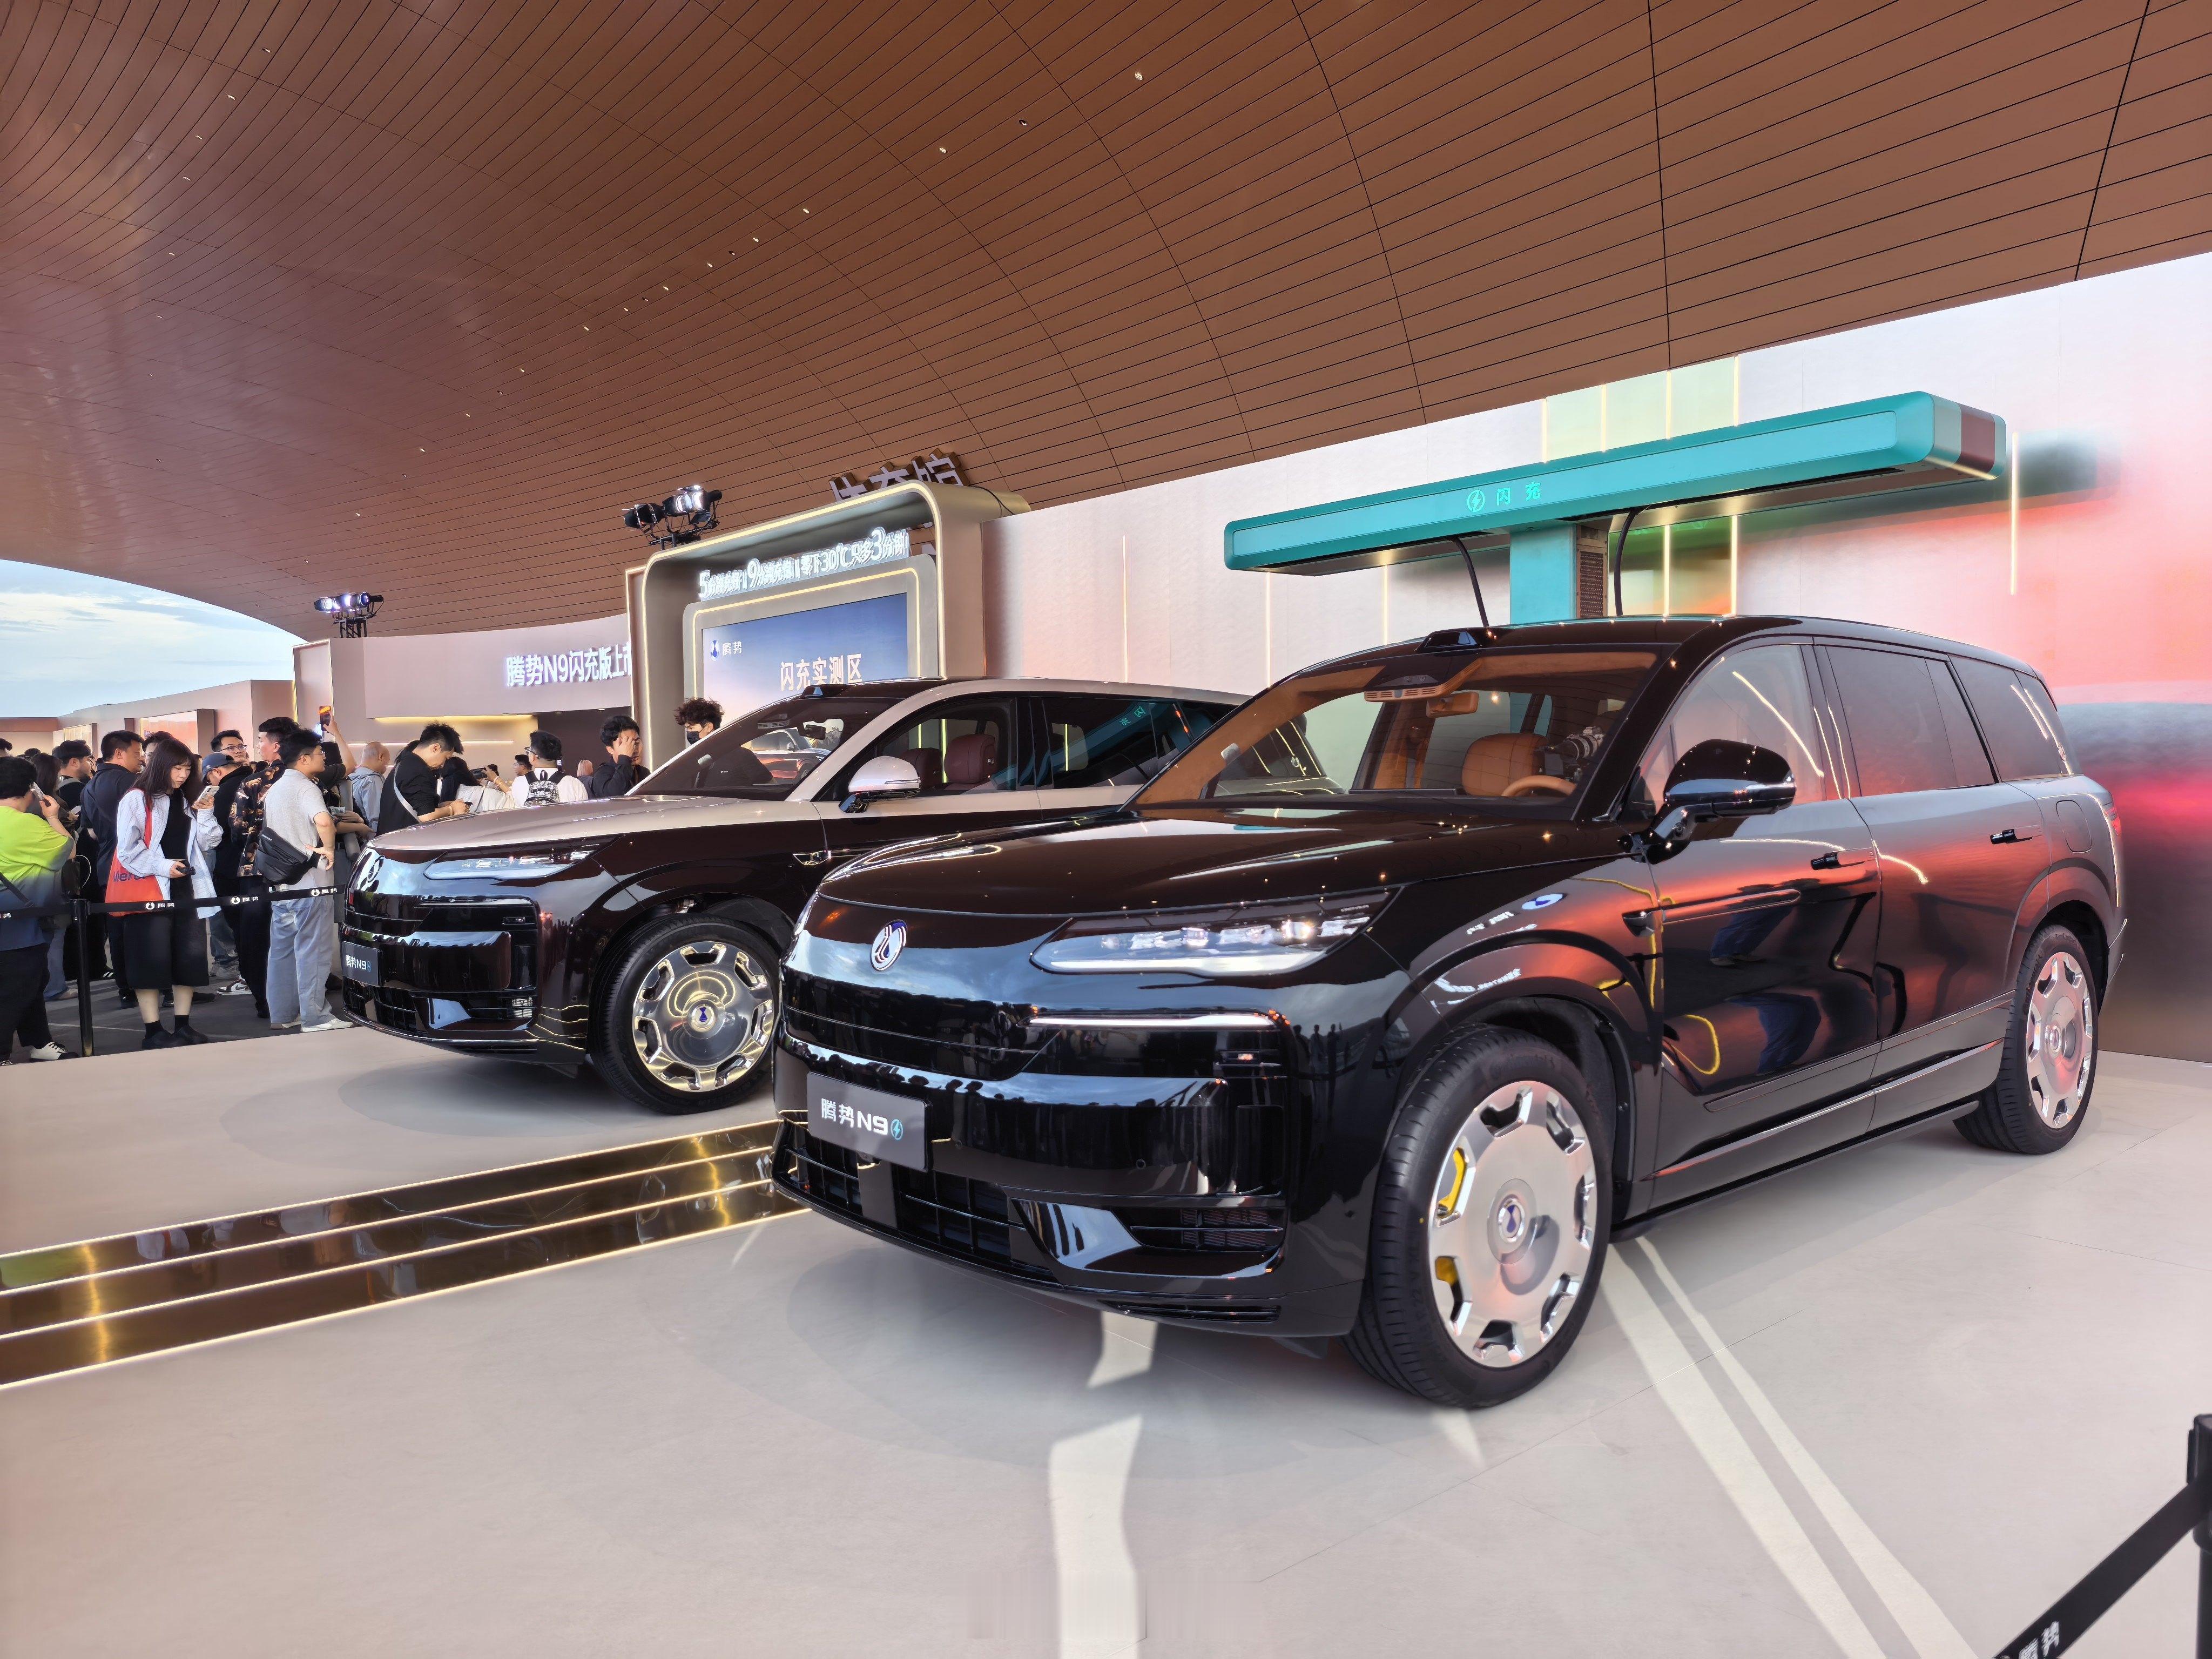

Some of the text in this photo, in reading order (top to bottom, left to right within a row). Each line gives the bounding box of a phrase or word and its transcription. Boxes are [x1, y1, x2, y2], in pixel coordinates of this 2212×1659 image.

[1496, 481, 1541, 506] 闪充
[780, 653, 862, 691] 闪充实测区
[821, 1097, 889, 1136] 腾势N9
